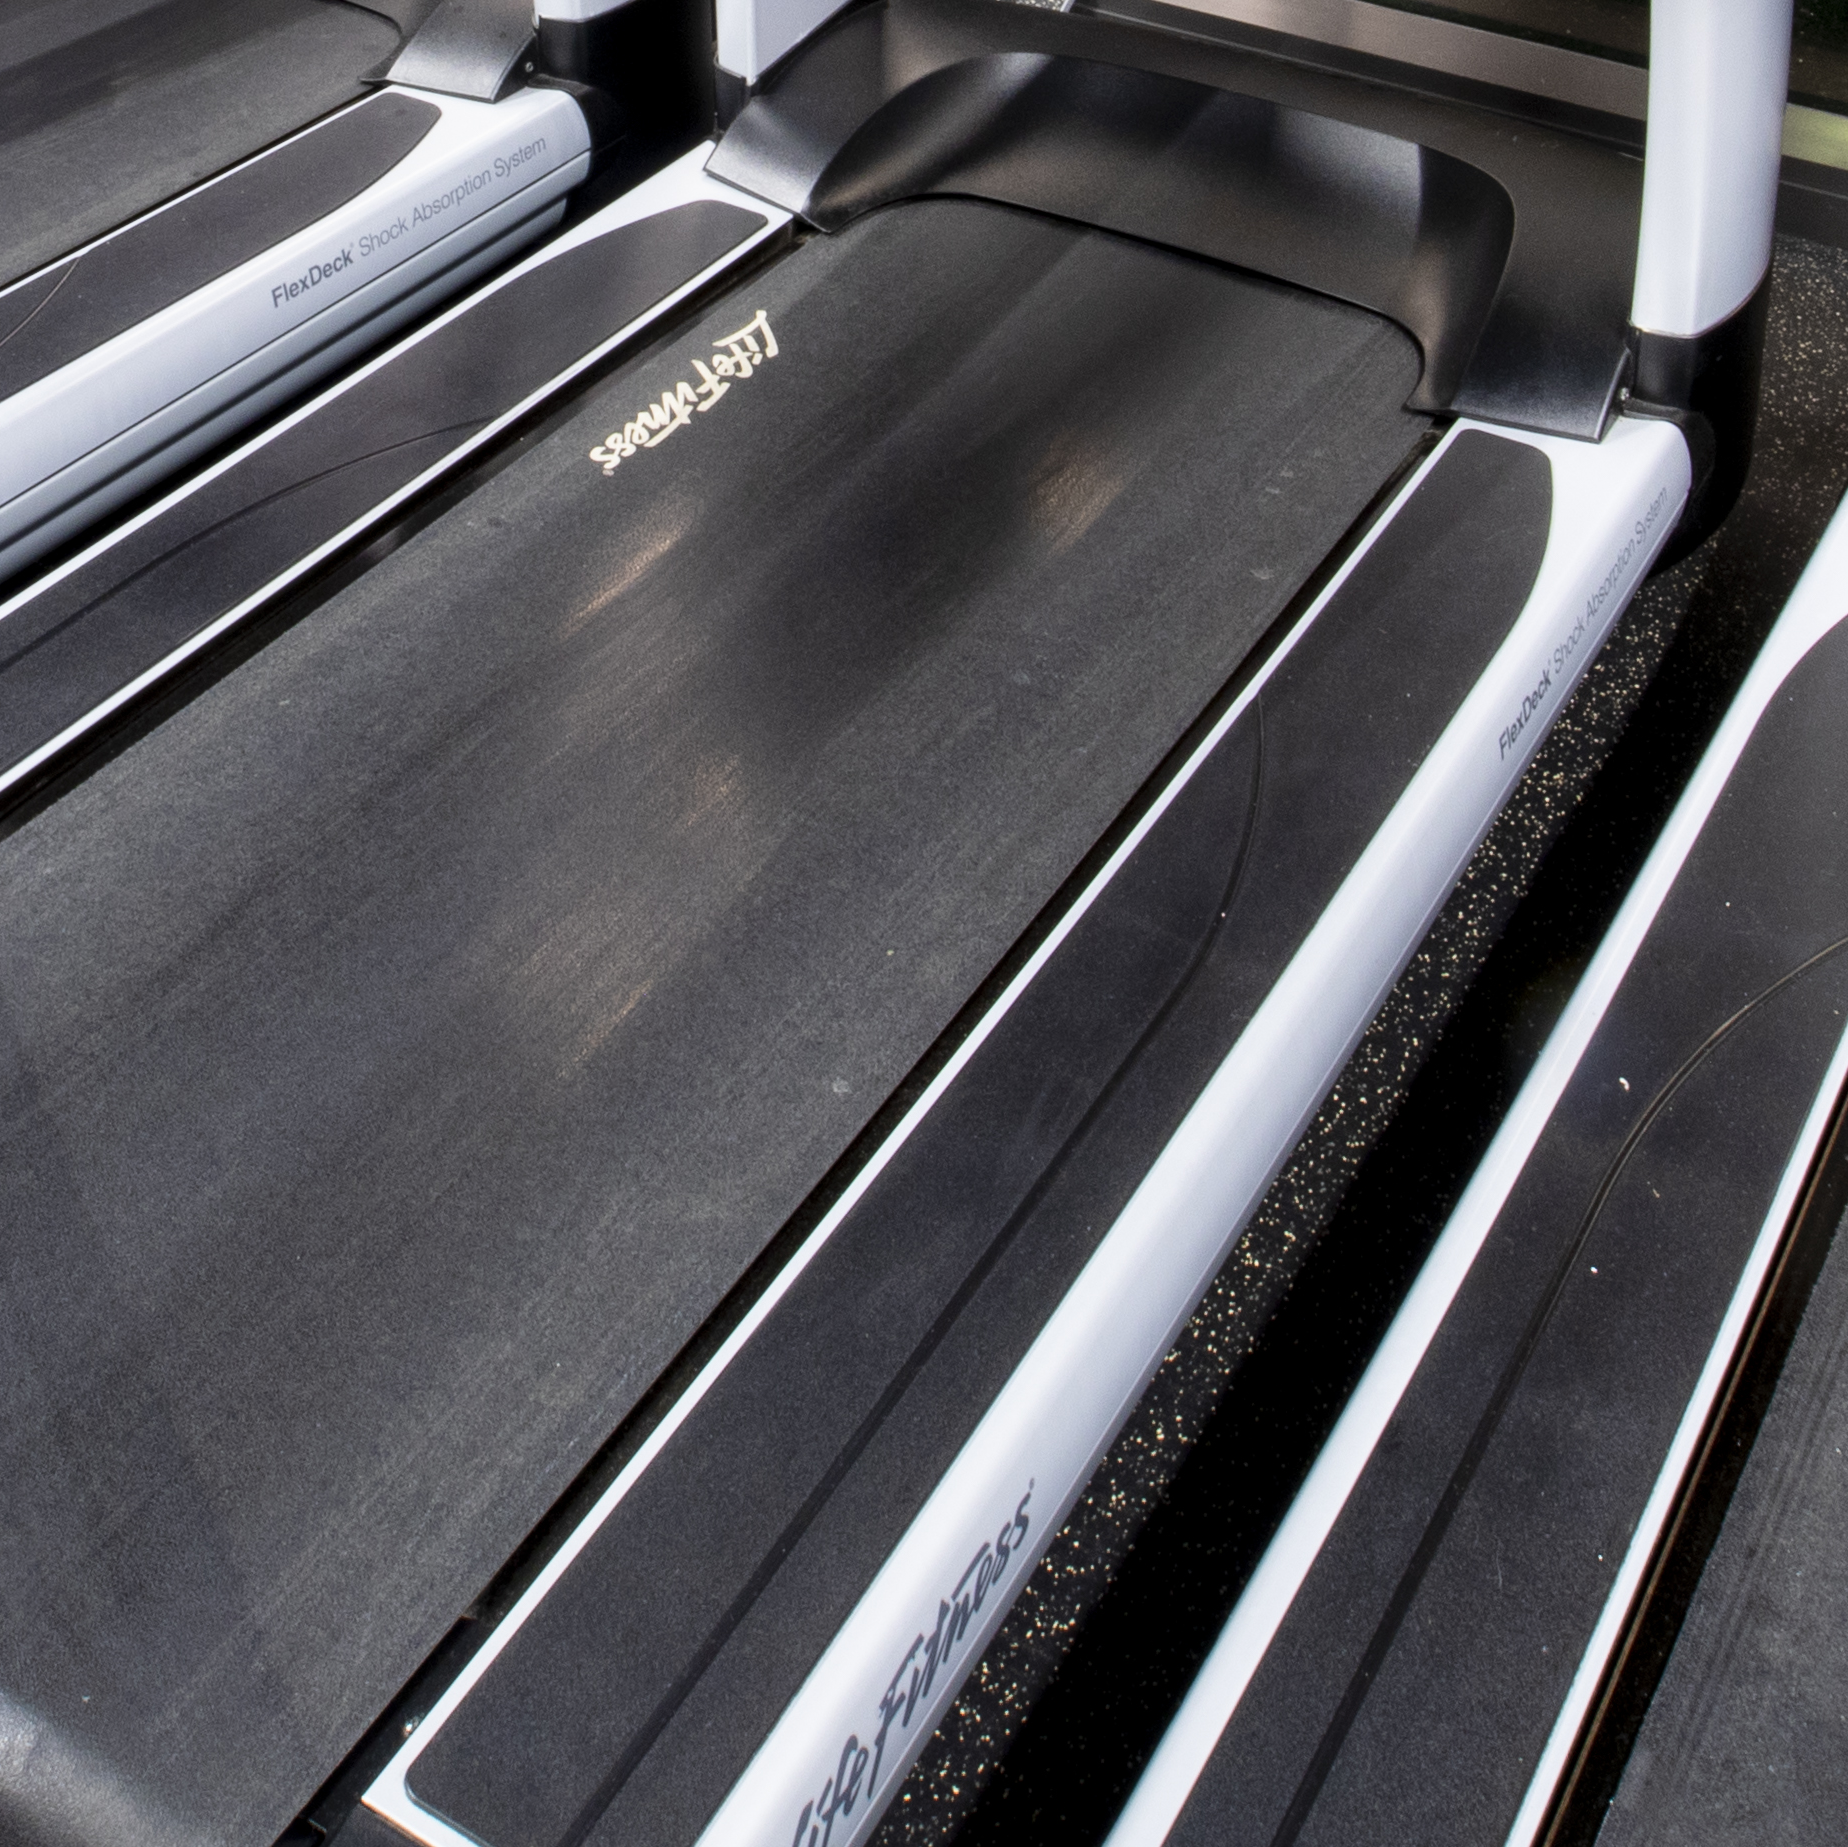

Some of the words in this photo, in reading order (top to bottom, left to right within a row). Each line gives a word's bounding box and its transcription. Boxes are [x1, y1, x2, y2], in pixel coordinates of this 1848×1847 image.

[270, 247, 354, 308] FlexDeck
[358, 217, 410, 257] Shock
[412, 169, 492, 229] Absorption
[493, 136, 548, 178] System
[589, 358, 732, 470] Fitness
[711, 309, 780, 378] Life
[1498, 668, 1552, 761] FlexDeck
[1553, 617, 1587, 674] Shock
[1585, 538, 1637, 627] Absorption
[1635, 486, 1669, 547] System
[867, 1492, 1032, 1800] Fitness
